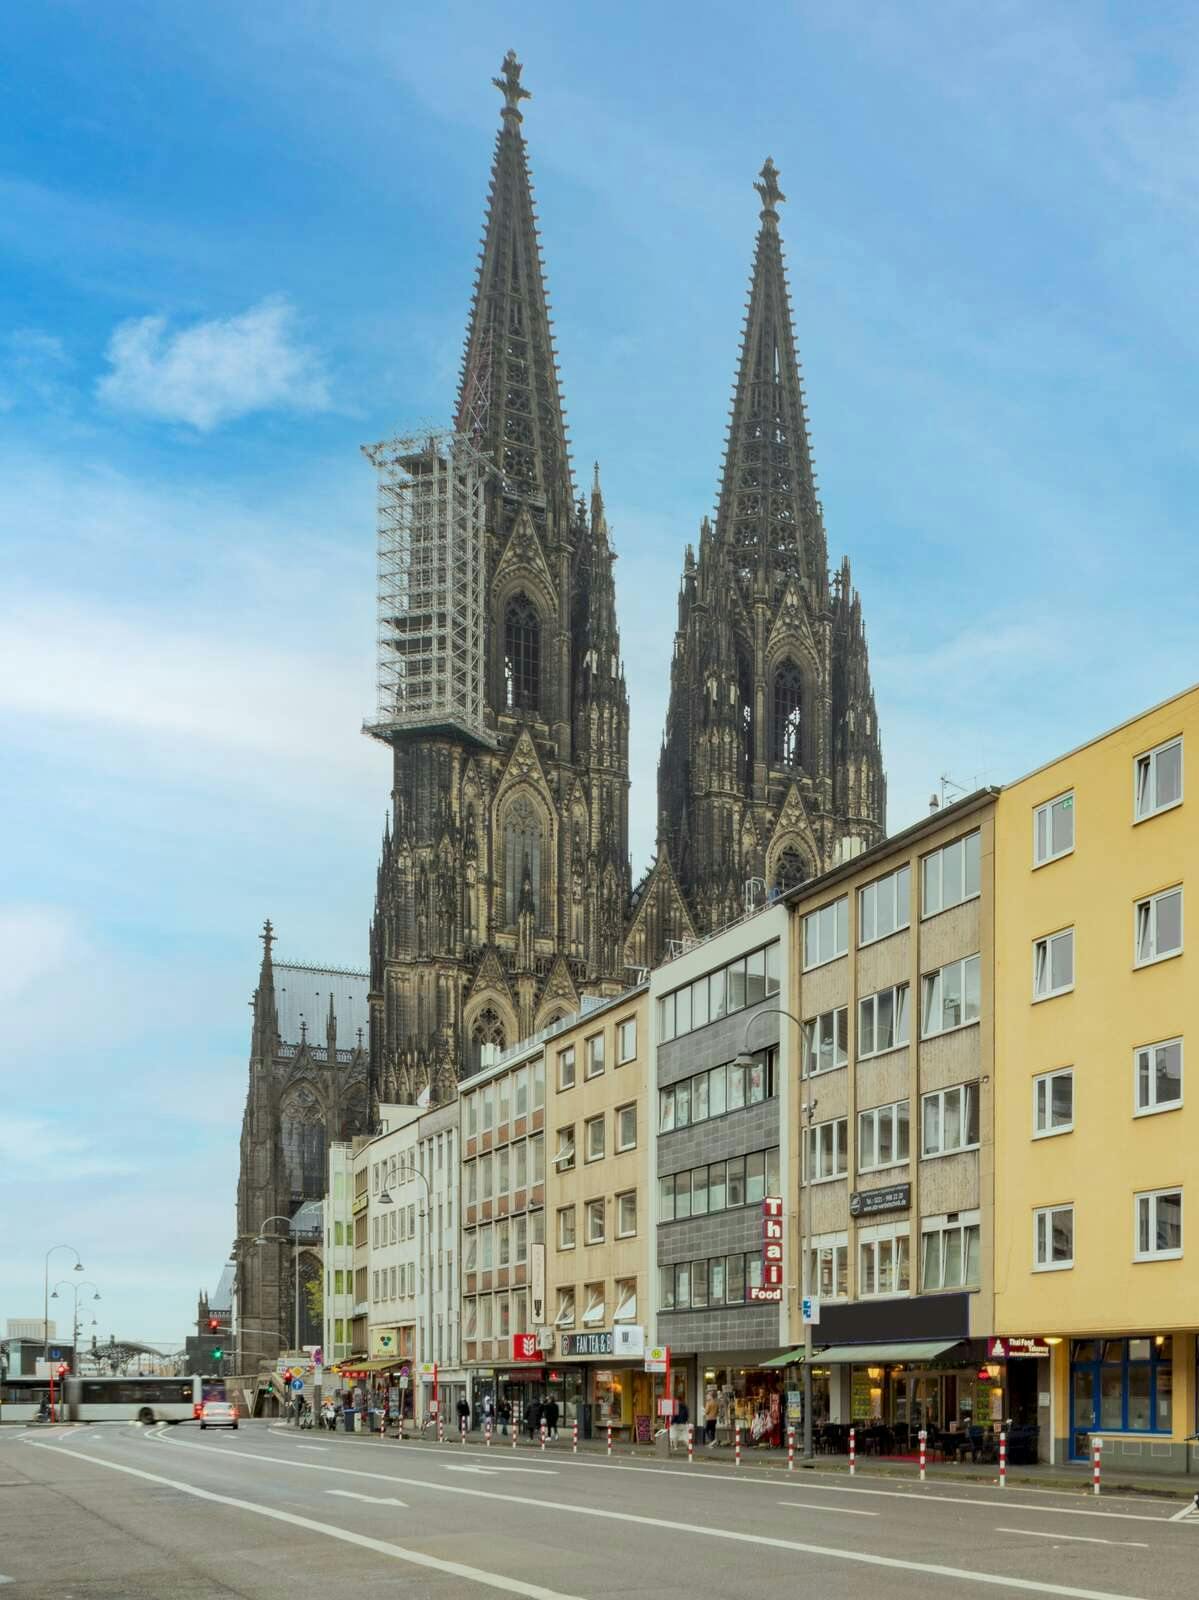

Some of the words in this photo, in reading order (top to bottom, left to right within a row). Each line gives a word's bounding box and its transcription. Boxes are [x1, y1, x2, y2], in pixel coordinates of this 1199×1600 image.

[766, 1198, 782, 1283] Thai
[751, 1288, 781, 1300] Food
[576, 1335, 588, 1353] FAN
[588, 1334, 600, 1353] TEA
